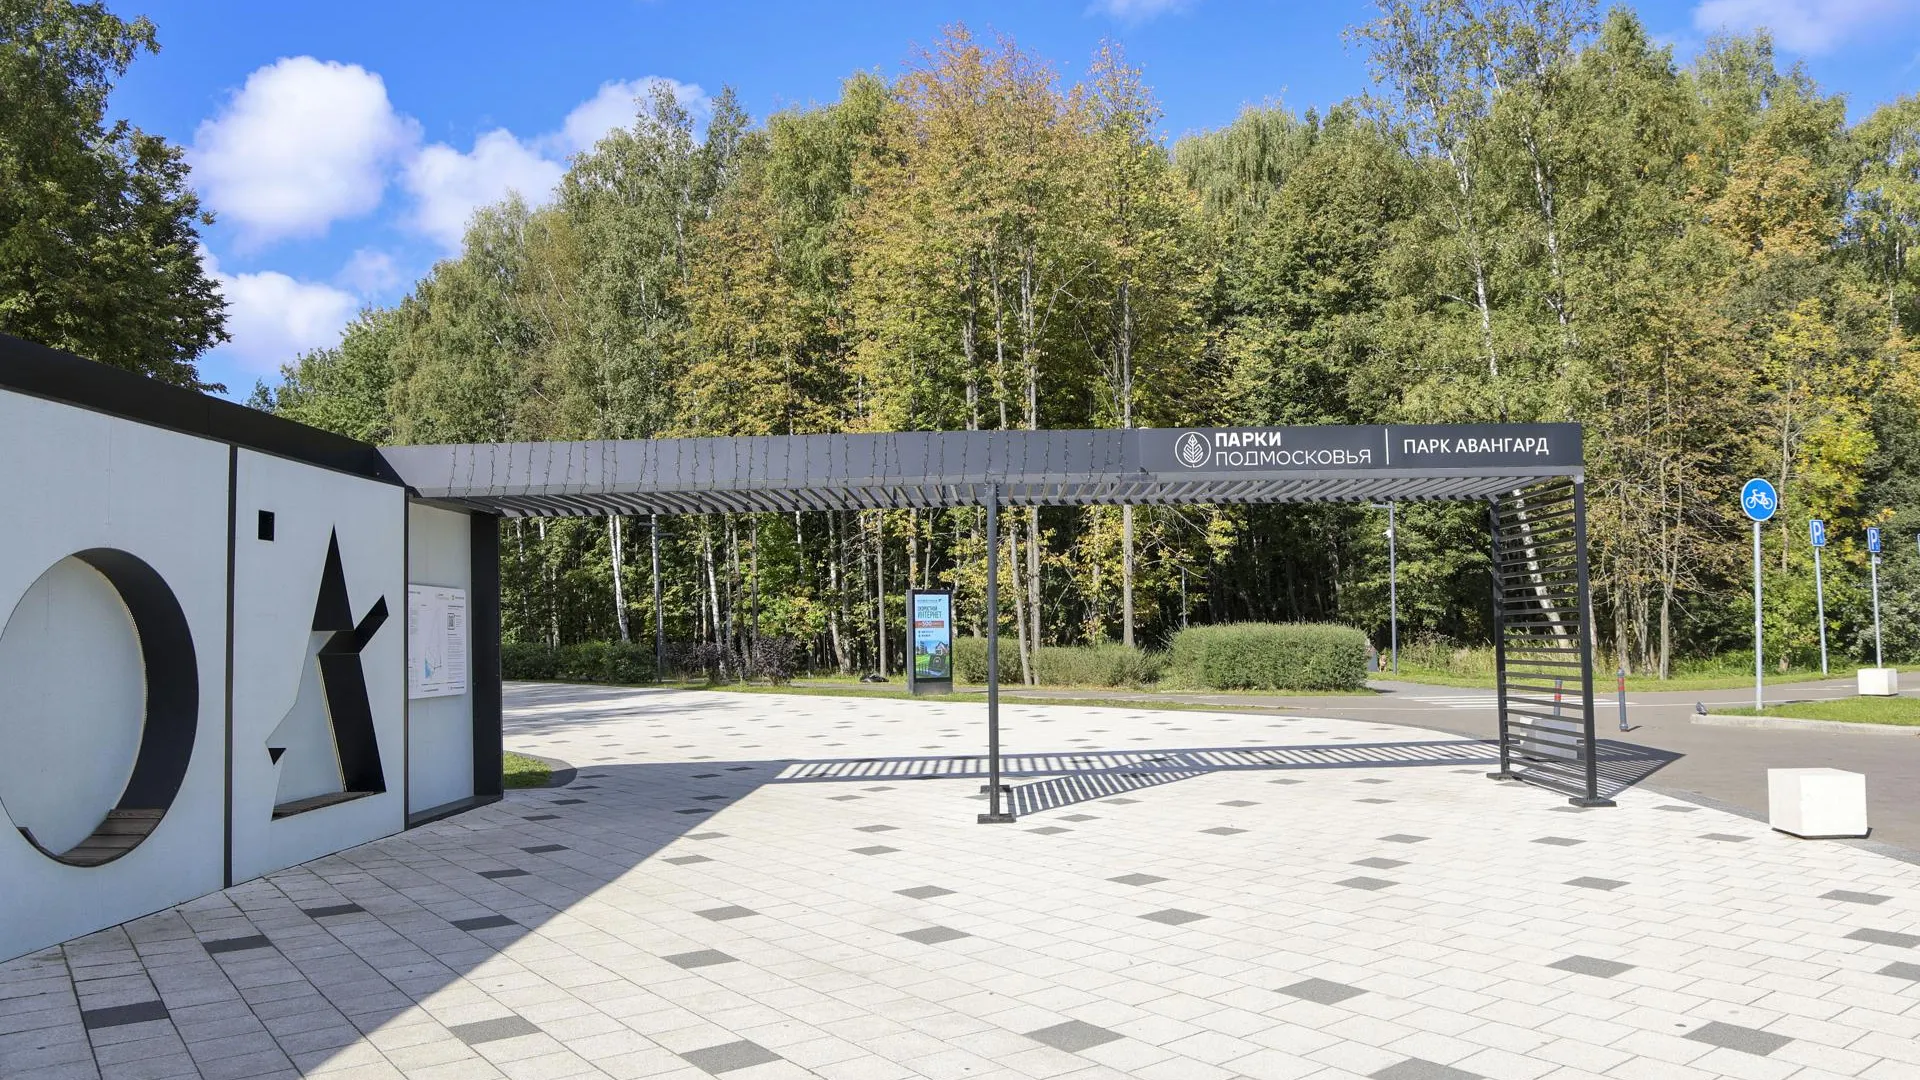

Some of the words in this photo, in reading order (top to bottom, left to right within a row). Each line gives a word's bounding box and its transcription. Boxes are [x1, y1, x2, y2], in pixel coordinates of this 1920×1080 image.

[1215, 432, 1282, 447] ПАРКИ
[1403, 439, 1451, 454] ПАРК
[1455, 437, 1550, 456] АВАНГАРД
[1215, 449, 1372, 466] ПОДМОСКОВЬЯ
[1813, 522, 1821, 543] P
[1870, 530, 1878, 549] P
